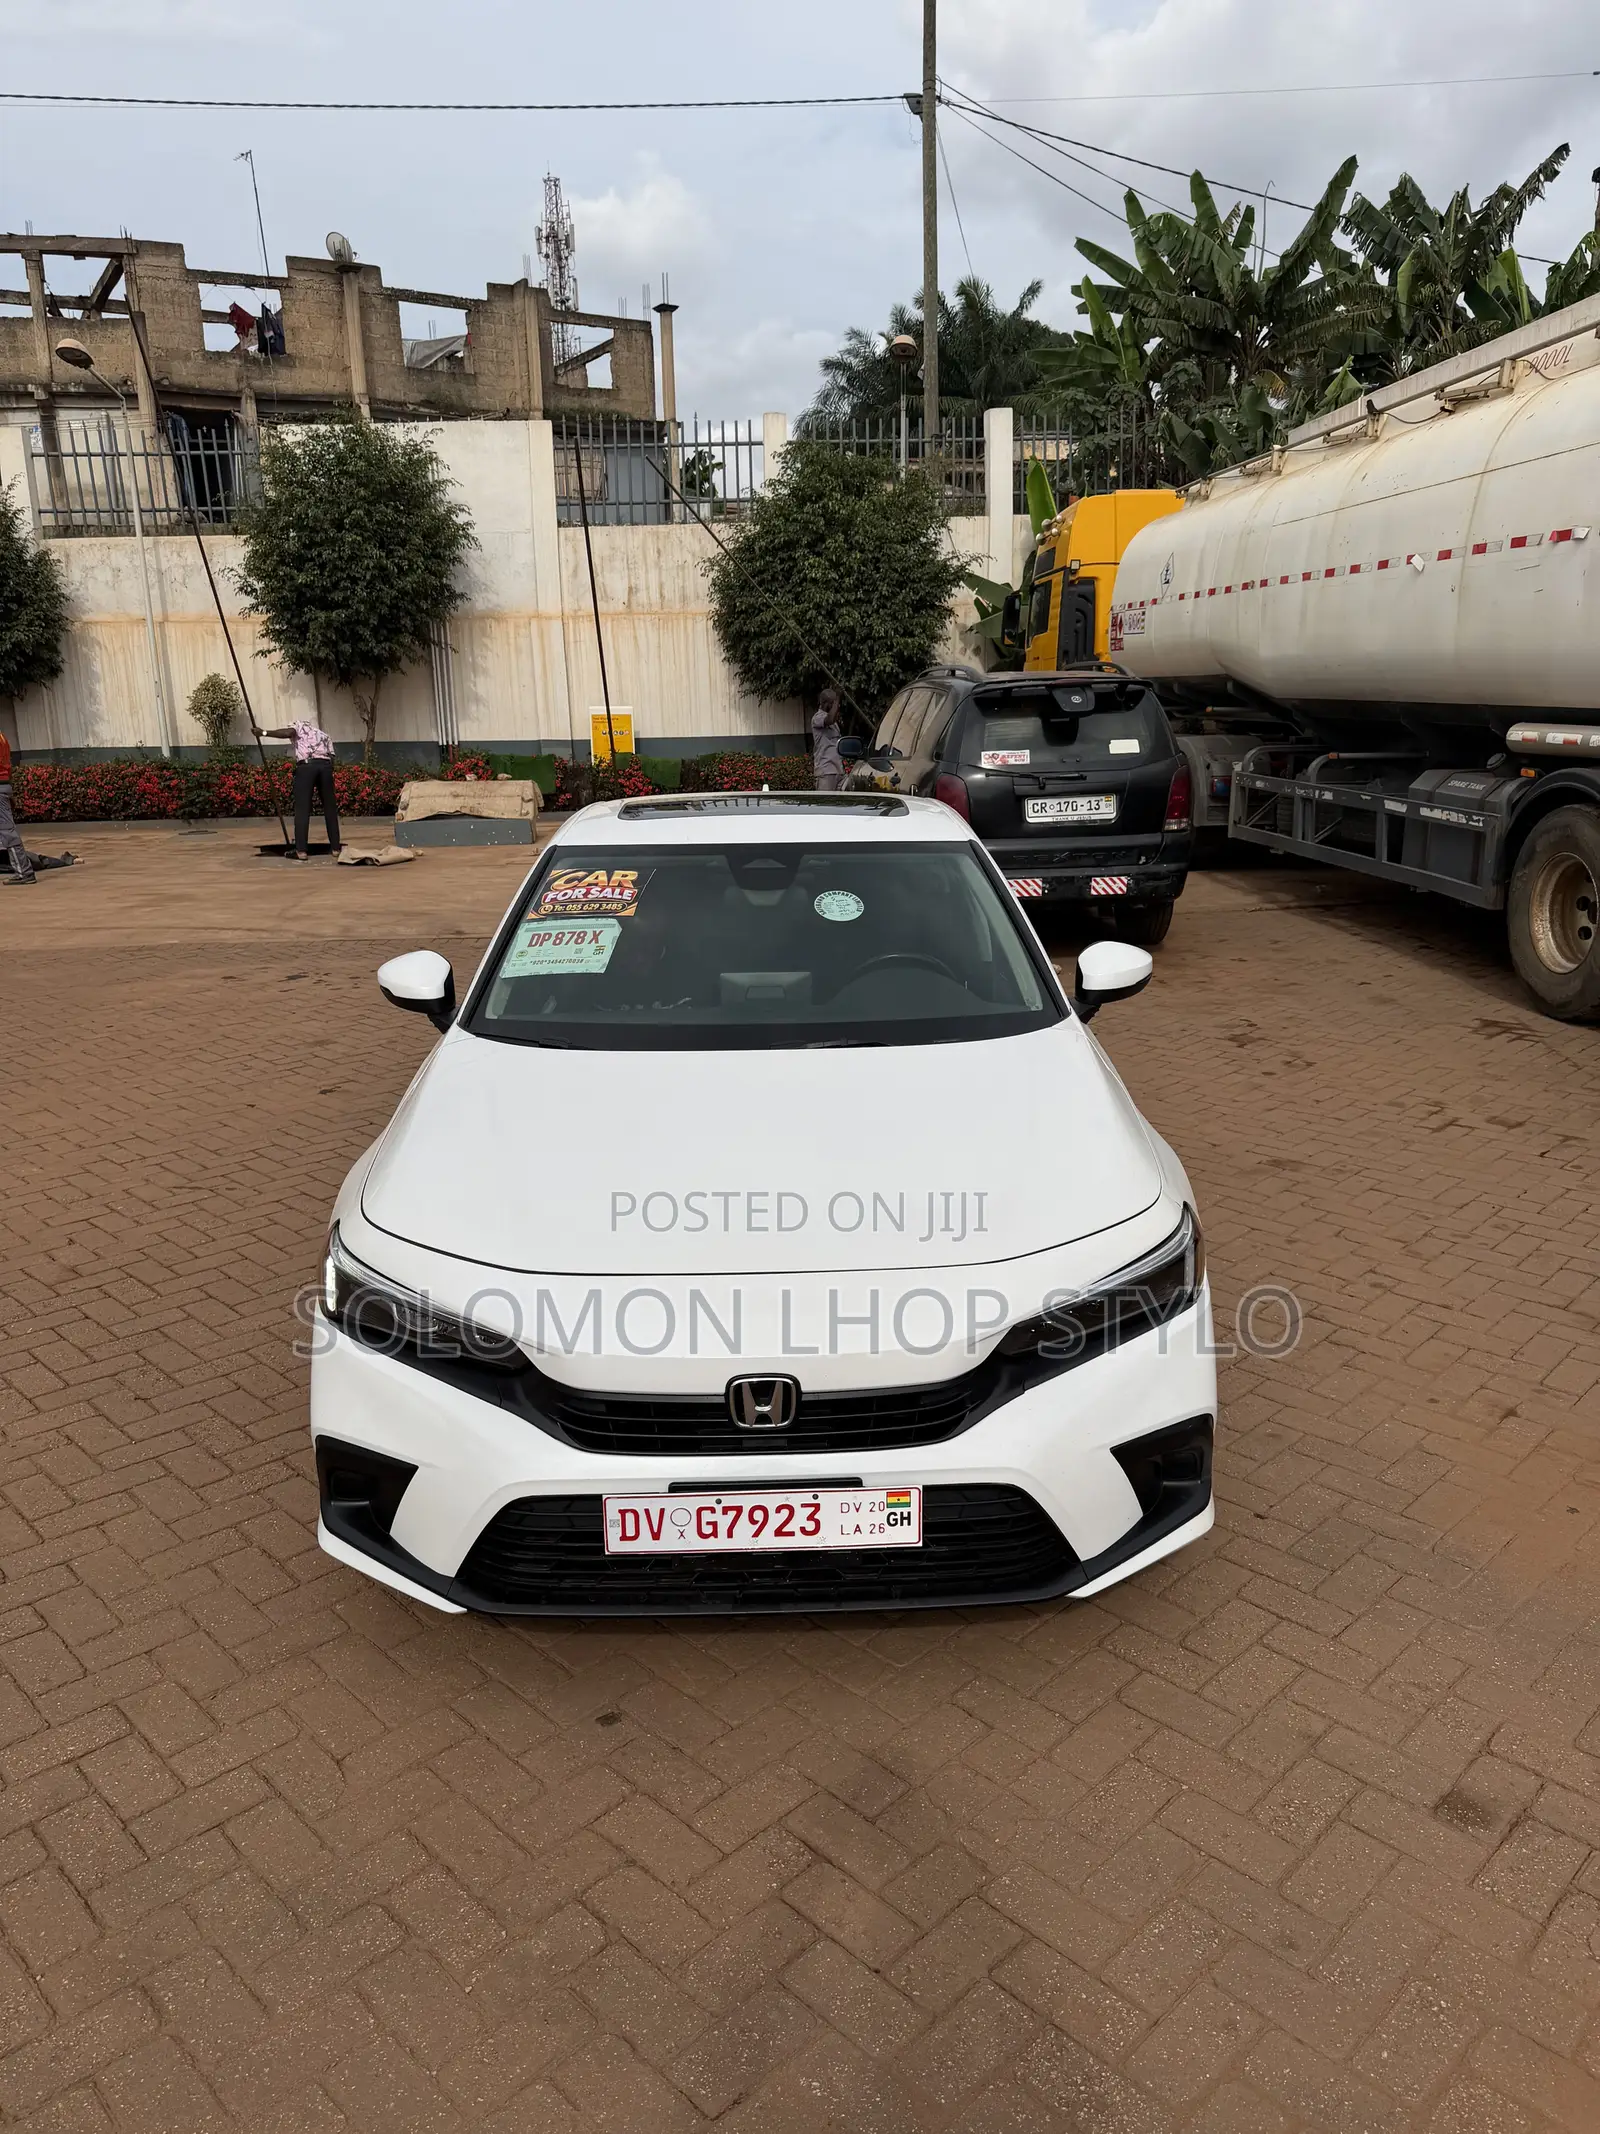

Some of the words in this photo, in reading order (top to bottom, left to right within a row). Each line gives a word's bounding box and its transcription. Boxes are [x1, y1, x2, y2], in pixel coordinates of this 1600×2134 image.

[1032, 802, 1047, 813] CR
[550, 870, 639, 891] CAR
[544, 888, 586, 903] FOR
[587, 887, 634, 901] SALE
[565, 903, 581, 911] 055
[840, 1502, 862, 1514] DV
[869, 1501, 886, 1512] 20
[618, 1507, 666, 1542] DV
[696, 1503, 822, 1540] G7923
[886, 1511, 912, 1527] GH
[840, 1524, 862, 1536] LA
[869, 1523, 886, 1534] 26
